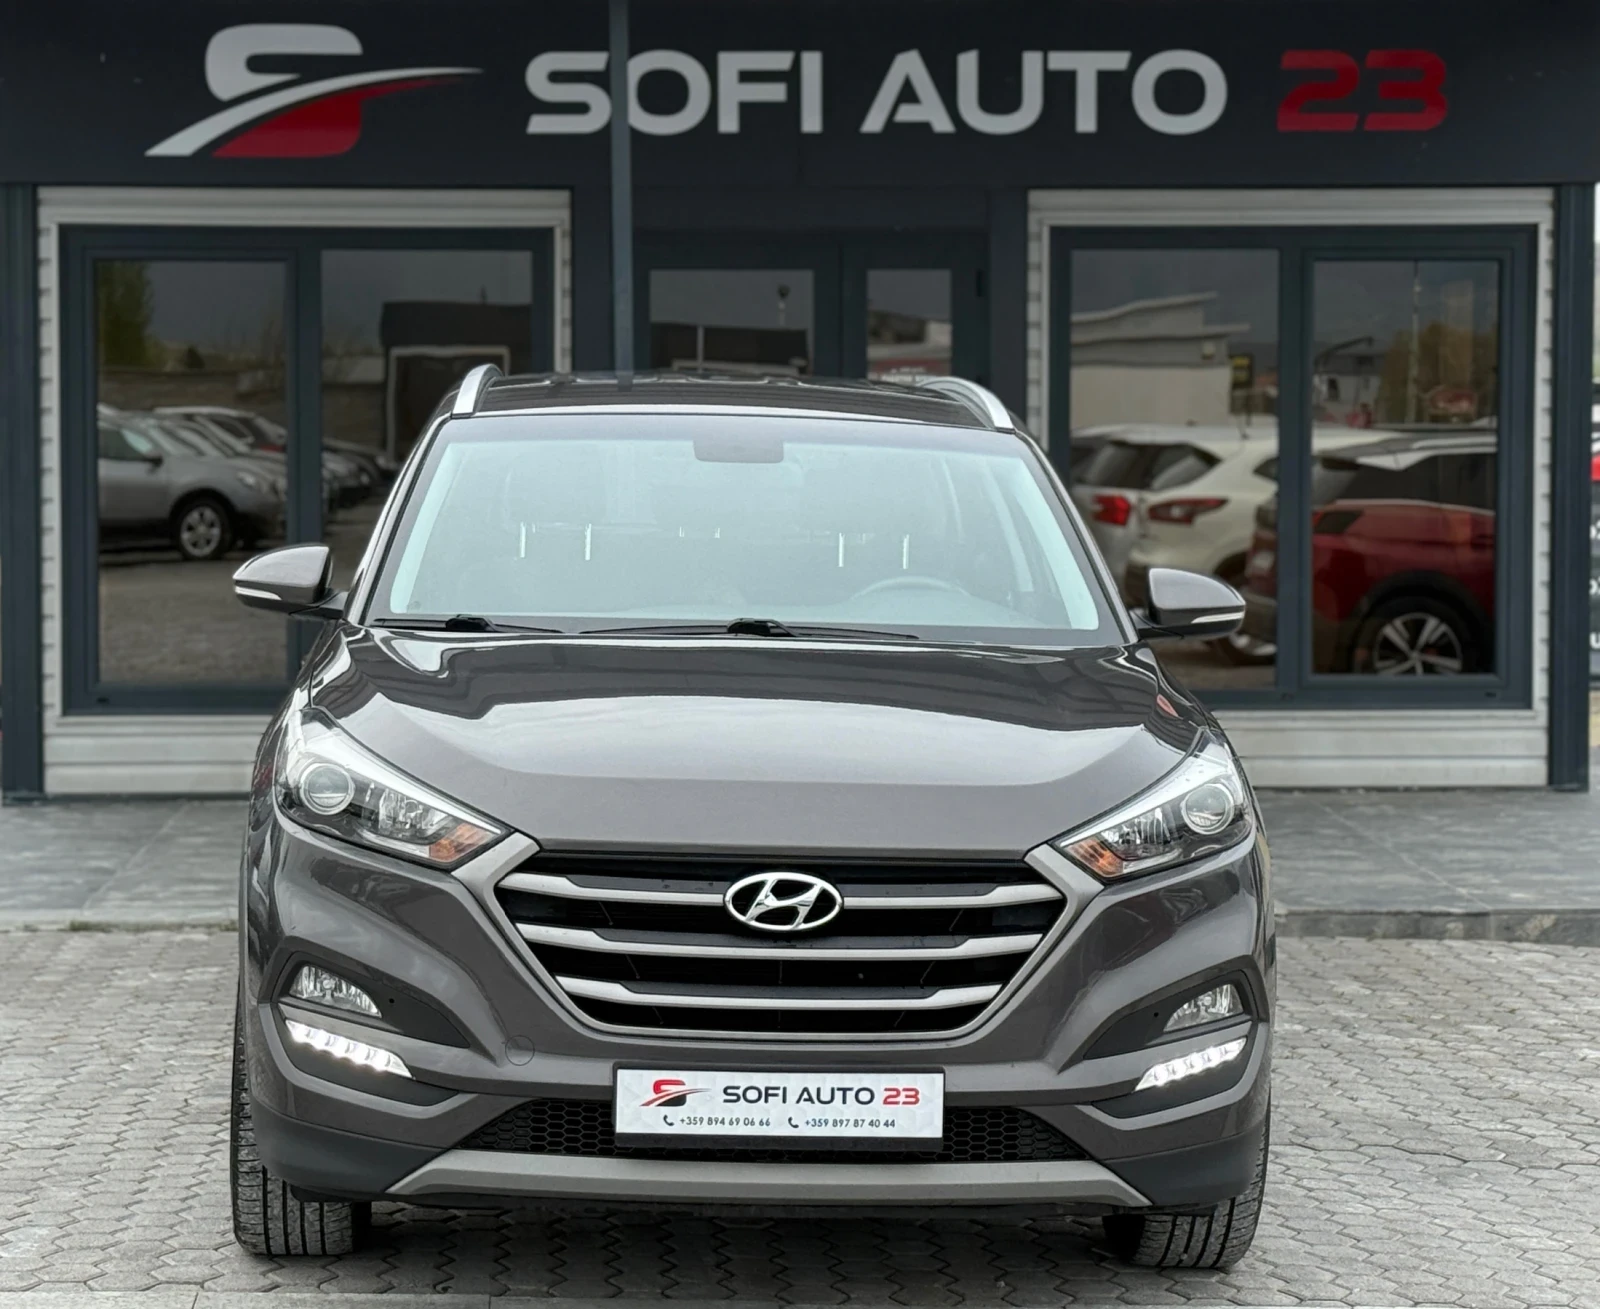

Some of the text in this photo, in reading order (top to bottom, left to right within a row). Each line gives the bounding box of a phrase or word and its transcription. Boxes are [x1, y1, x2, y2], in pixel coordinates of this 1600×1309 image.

[525, 49, 1448, 135] SOFI AUTO 23
[722, 1085, 920, 1105] SOFI AUTO 23
[680, 1116, 771, 1127] +359 894 69 06 66
[805, 1118, 896, 1128] +359 897 87 40 44
